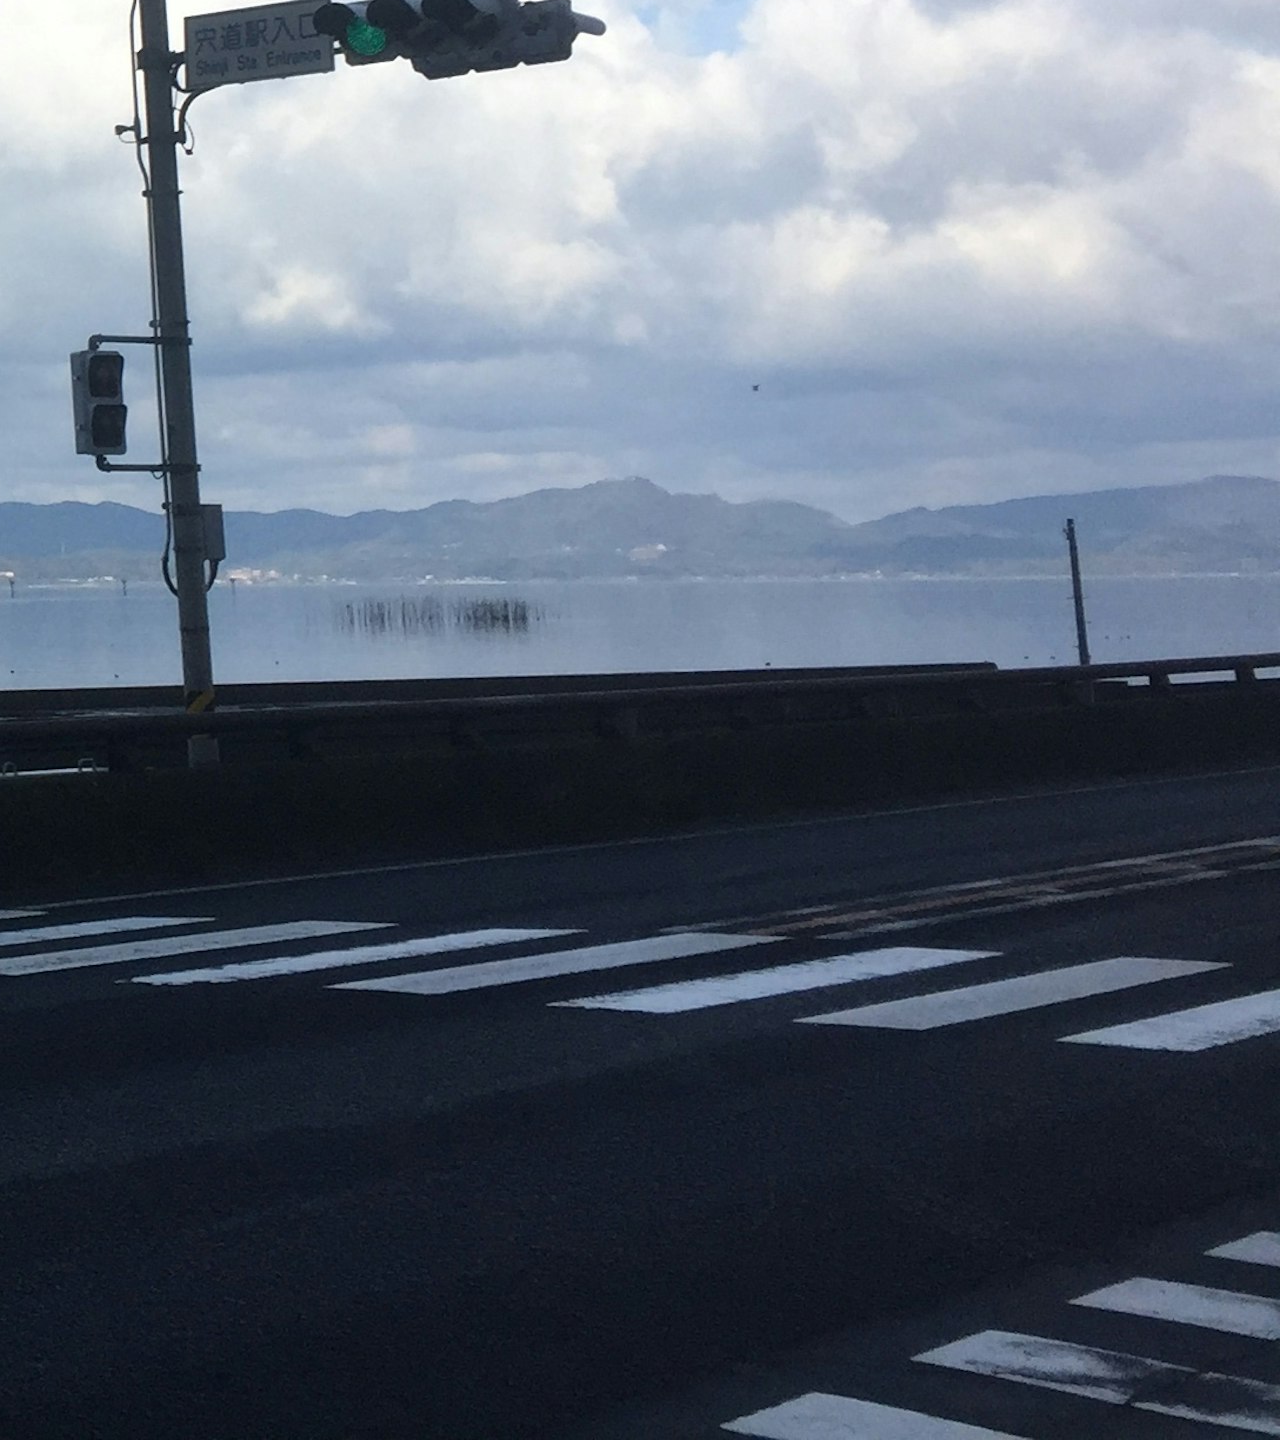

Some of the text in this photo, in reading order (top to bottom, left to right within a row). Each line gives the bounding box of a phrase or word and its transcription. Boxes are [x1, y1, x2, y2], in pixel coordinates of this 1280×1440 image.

[195, 13, 320, 55] 宍道駅入口
[267, 48, 321, 68] Entrance
